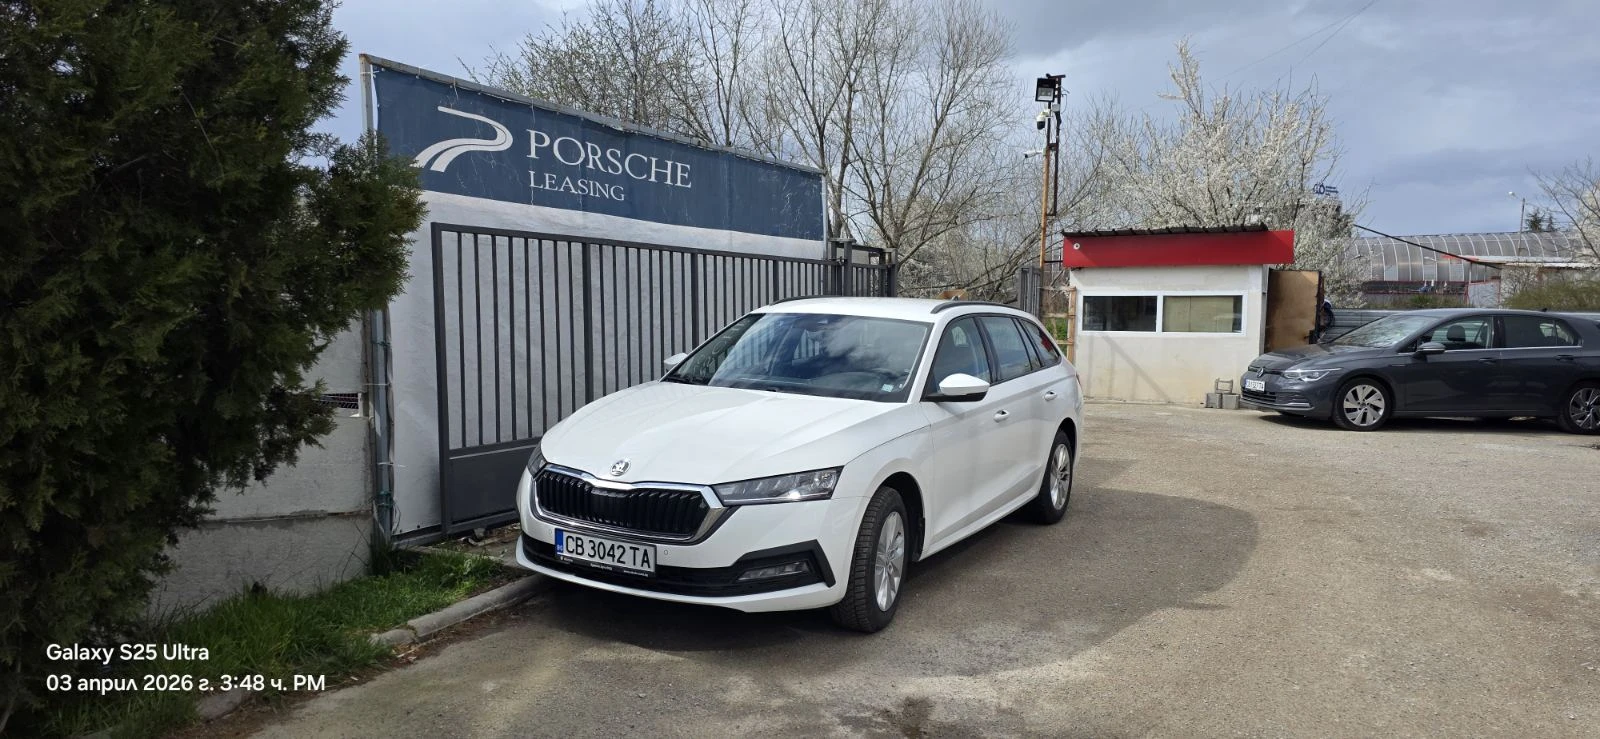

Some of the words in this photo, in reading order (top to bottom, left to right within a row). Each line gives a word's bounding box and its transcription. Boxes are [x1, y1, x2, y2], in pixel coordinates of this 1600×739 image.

[526, 129, 692, 188] PORSCHE
[528, 170, 625, 201] LEASING
[565, 536, 585, 555] CB
[588, 540, 626, 564] 3042
[629, 546, 651, 568] TA
